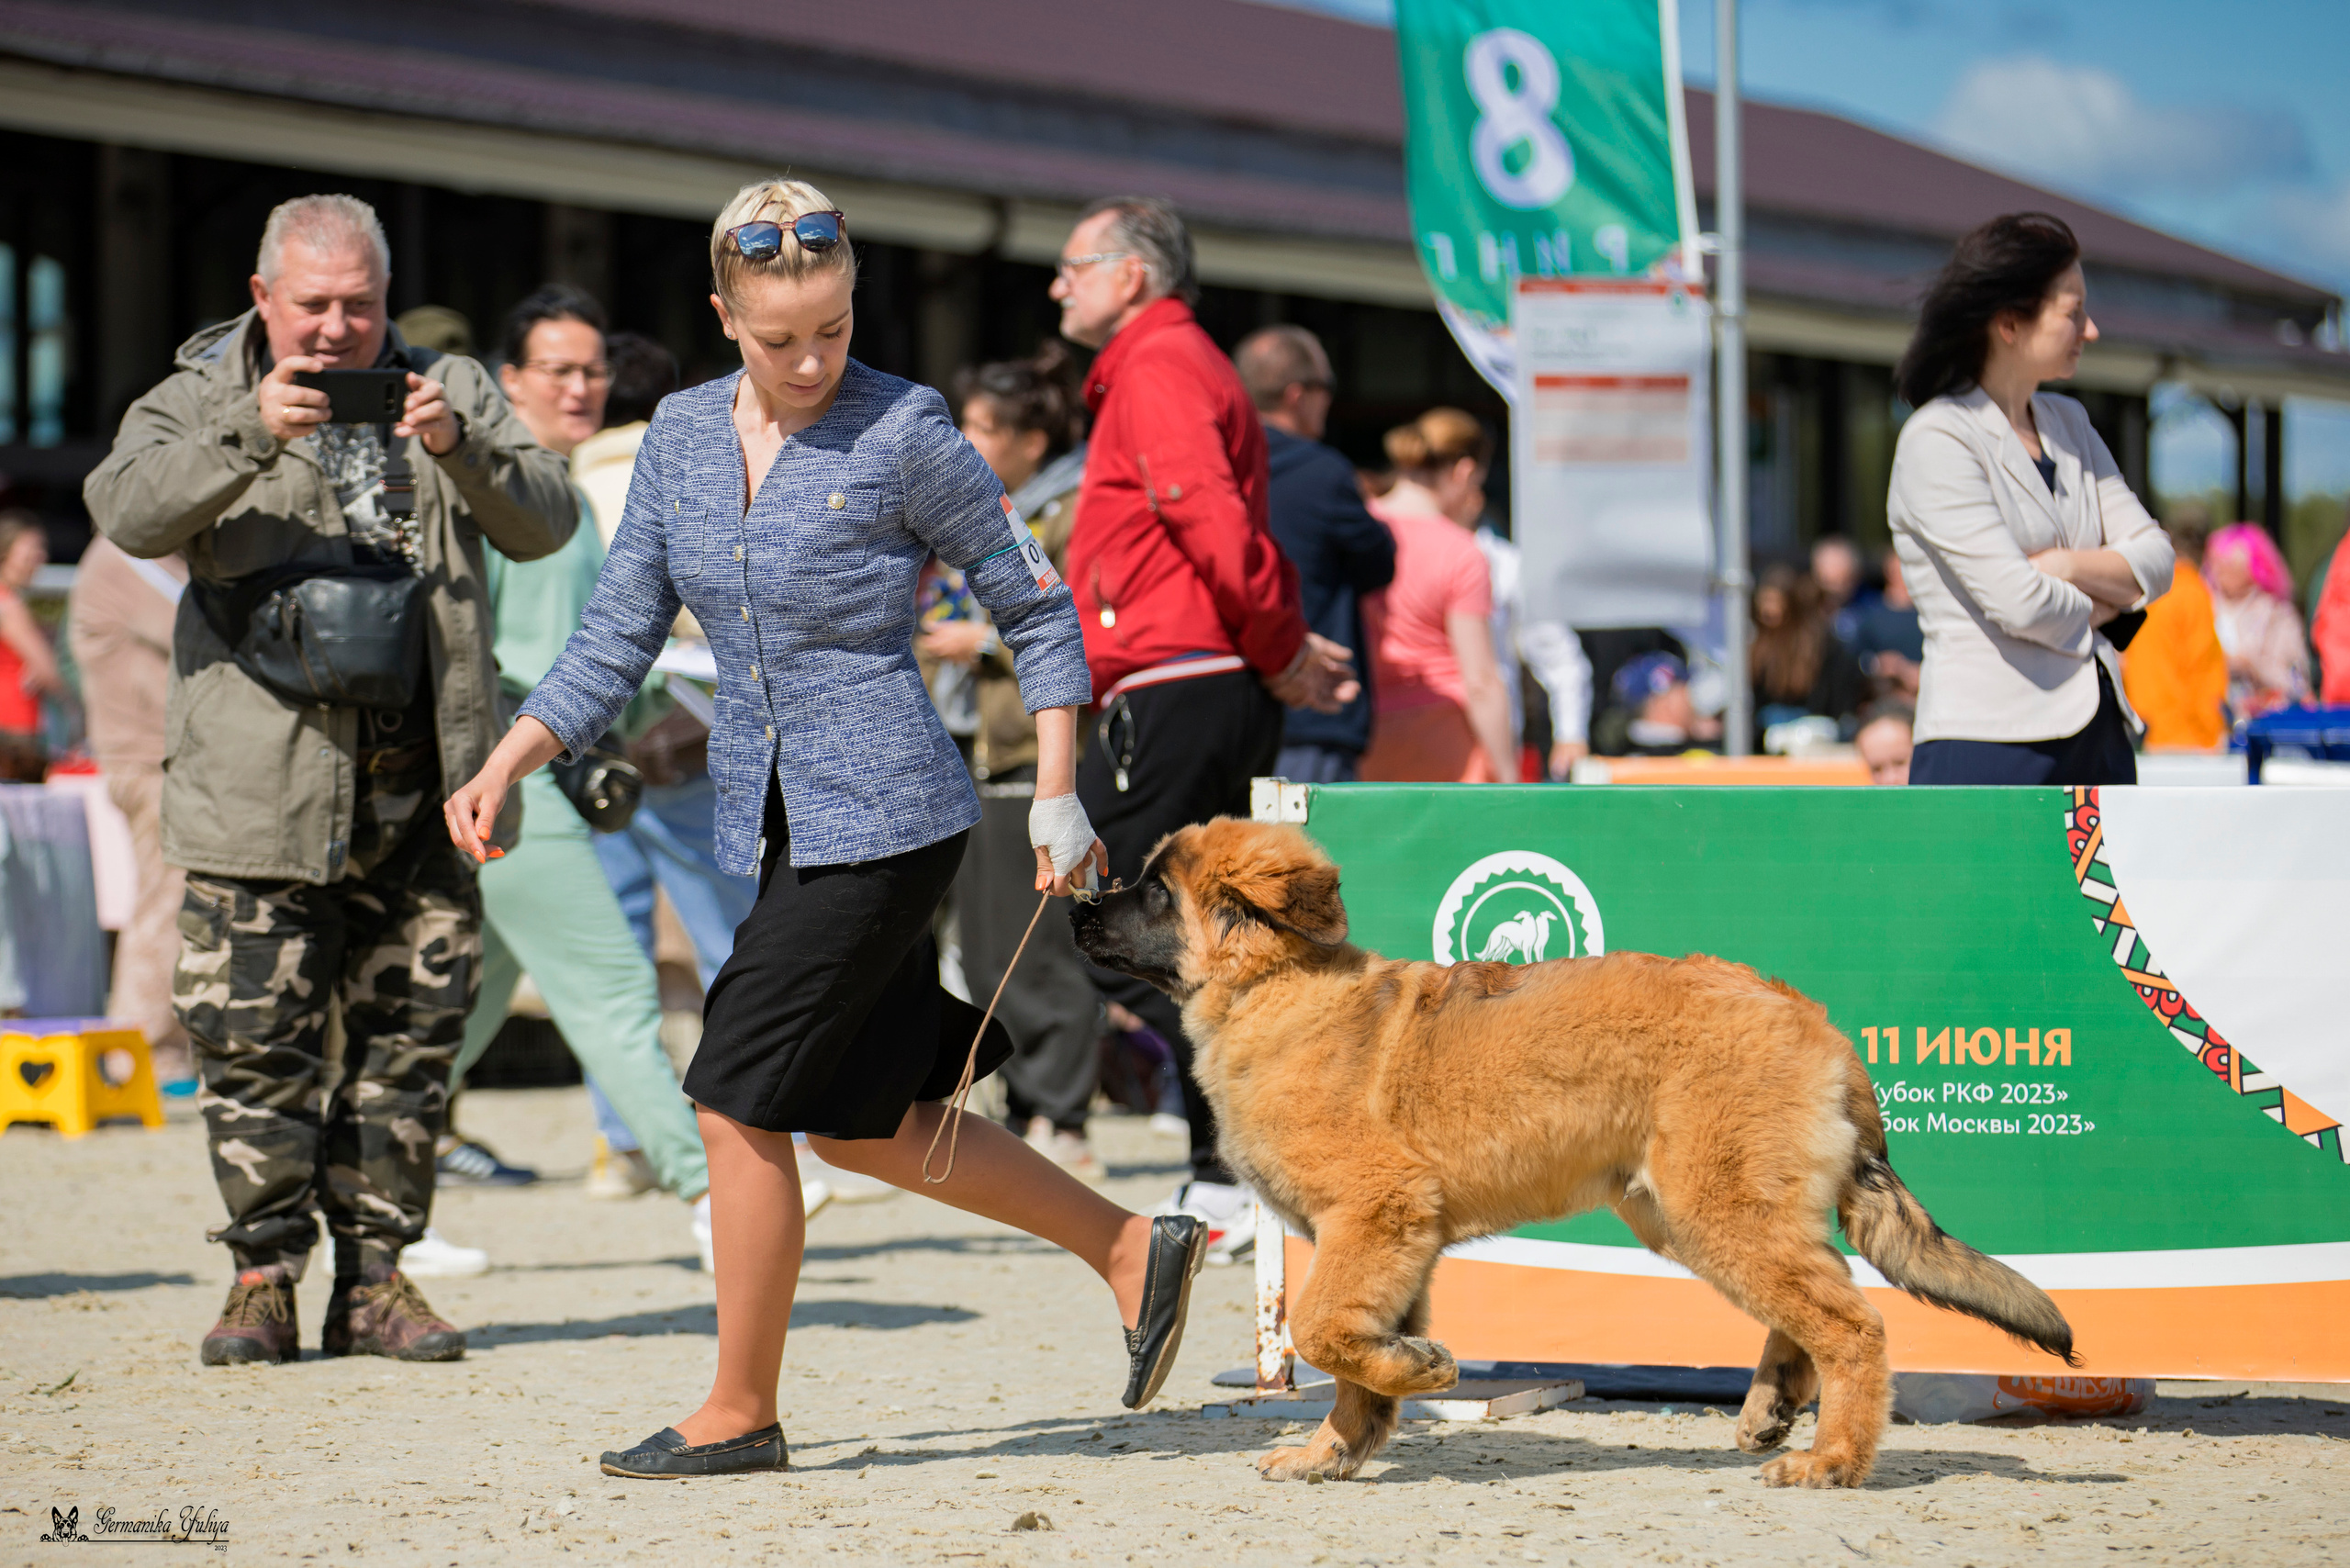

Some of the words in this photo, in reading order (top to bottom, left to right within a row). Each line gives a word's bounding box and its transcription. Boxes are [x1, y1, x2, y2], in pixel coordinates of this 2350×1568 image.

[1861, 1026, 1899, 1064] 11
[1916, 1026, 2072, 1066] ИЮНЯ
[1942, 1082, 1994, 1103] РКФ
[1999, 1083, 2068, 1104] 2023»
[1880, 1110, 1920, 1133] бок
[1927, 1112, 2020, 1134] Москвы
[2027, 1114, 2096, 1135] 2023»
